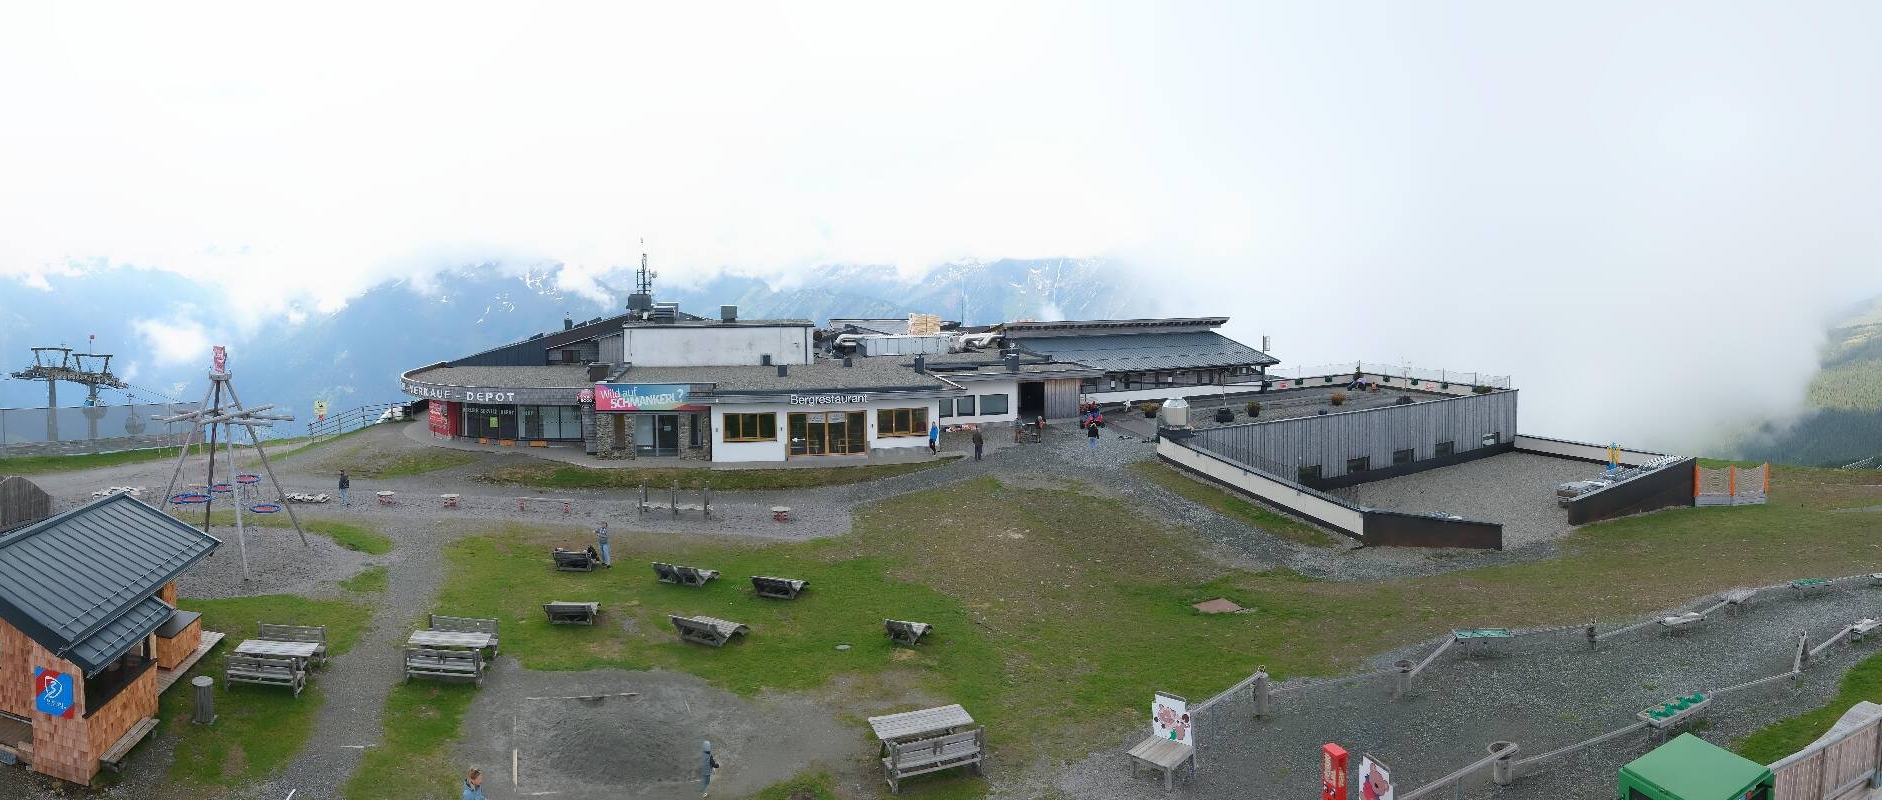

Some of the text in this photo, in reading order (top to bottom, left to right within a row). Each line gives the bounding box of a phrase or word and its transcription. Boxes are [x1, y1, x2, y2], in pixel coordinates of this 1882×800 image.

[466, 392, 515, 402] DEPOT
[601, 386, 638, 399] Wild auf
[790, 393, 868, 406] Bergrestaurant
